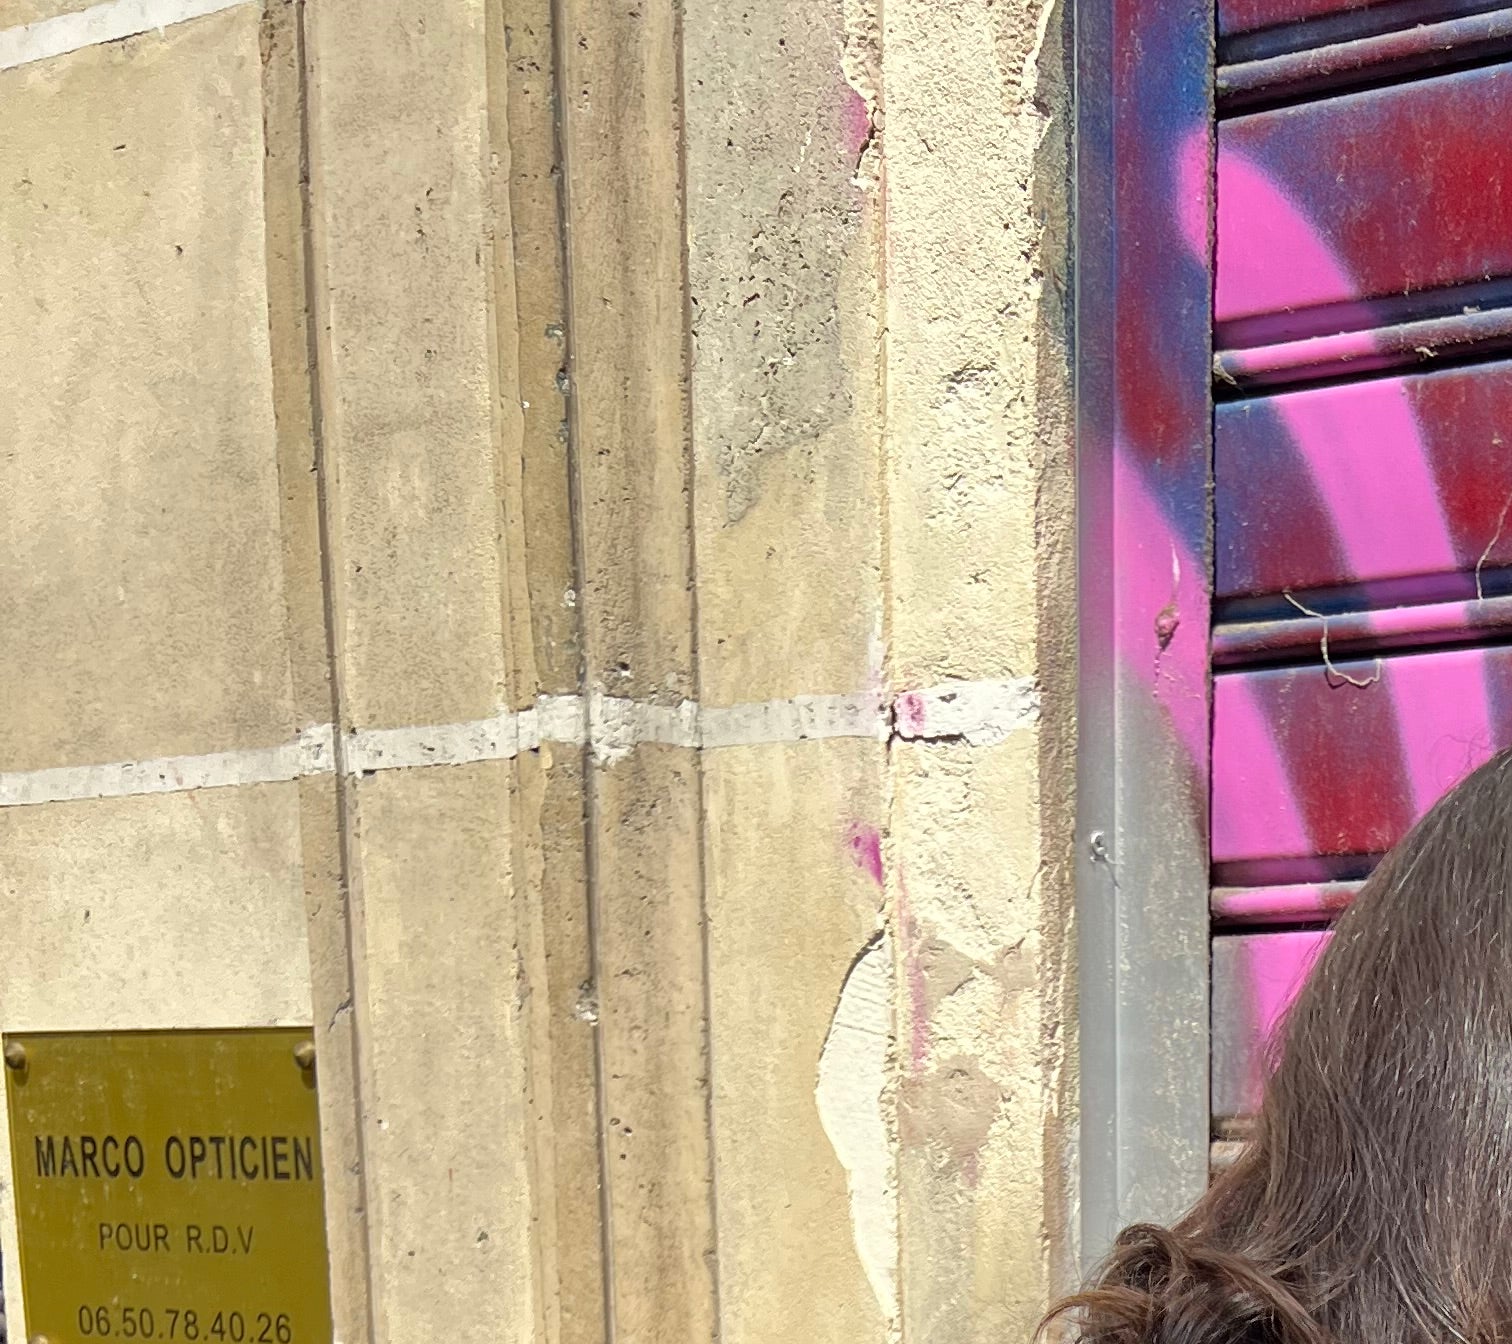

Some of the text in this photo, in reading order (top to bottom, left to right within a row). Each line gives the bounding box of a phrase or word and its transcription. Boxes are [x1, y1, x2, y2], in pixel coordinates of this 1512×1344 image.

[35, 1135, 314, 1181] MARCO OPTICIEN
[100, 1223, 254, 1254] POUR R.D.V
[78, 1305, 292, 1344] 06.50.78.40.26
